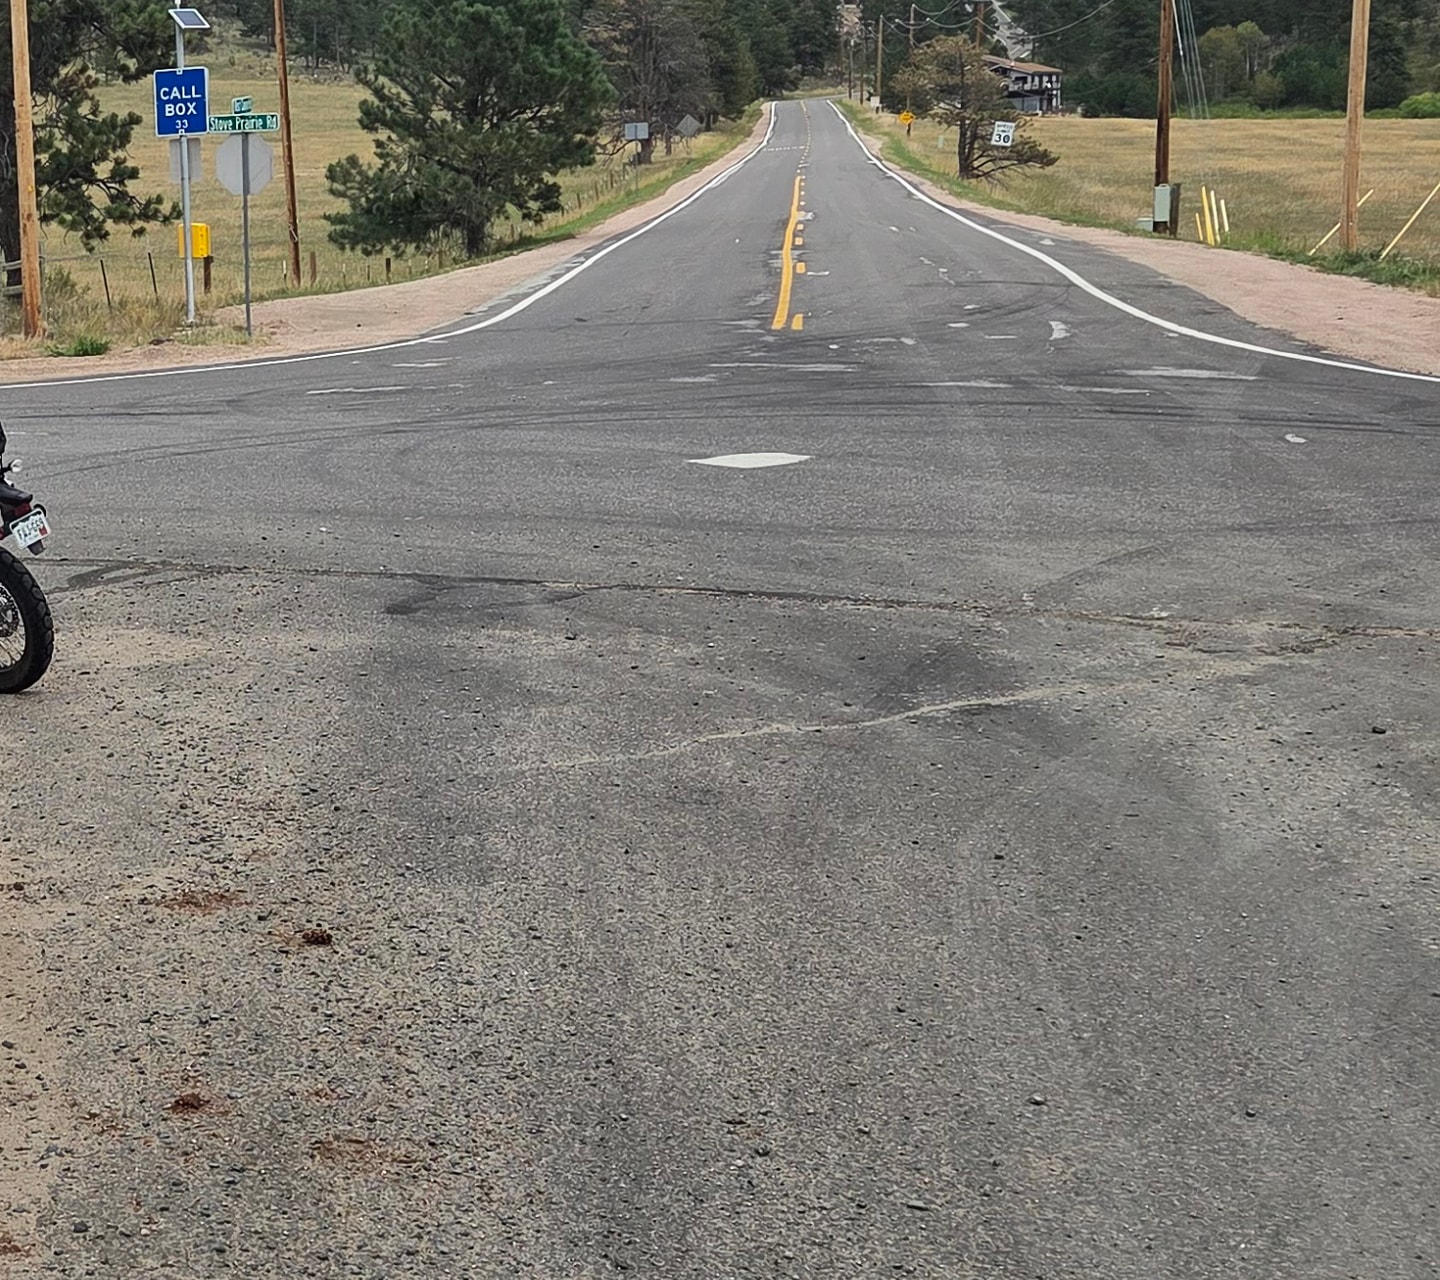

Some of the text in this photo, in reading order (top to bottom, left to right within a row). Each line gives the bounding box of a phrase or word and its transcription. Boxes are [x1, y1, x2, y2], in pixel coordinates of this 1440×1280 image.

[160, 85, 202, 100] CALL
[165, 102, 197, 117] BOX
[175, 119, 189, 129] 33
[210, 115, 277, 131] Stove Prairie Rd
[994, 133, 1010, 143] 30
